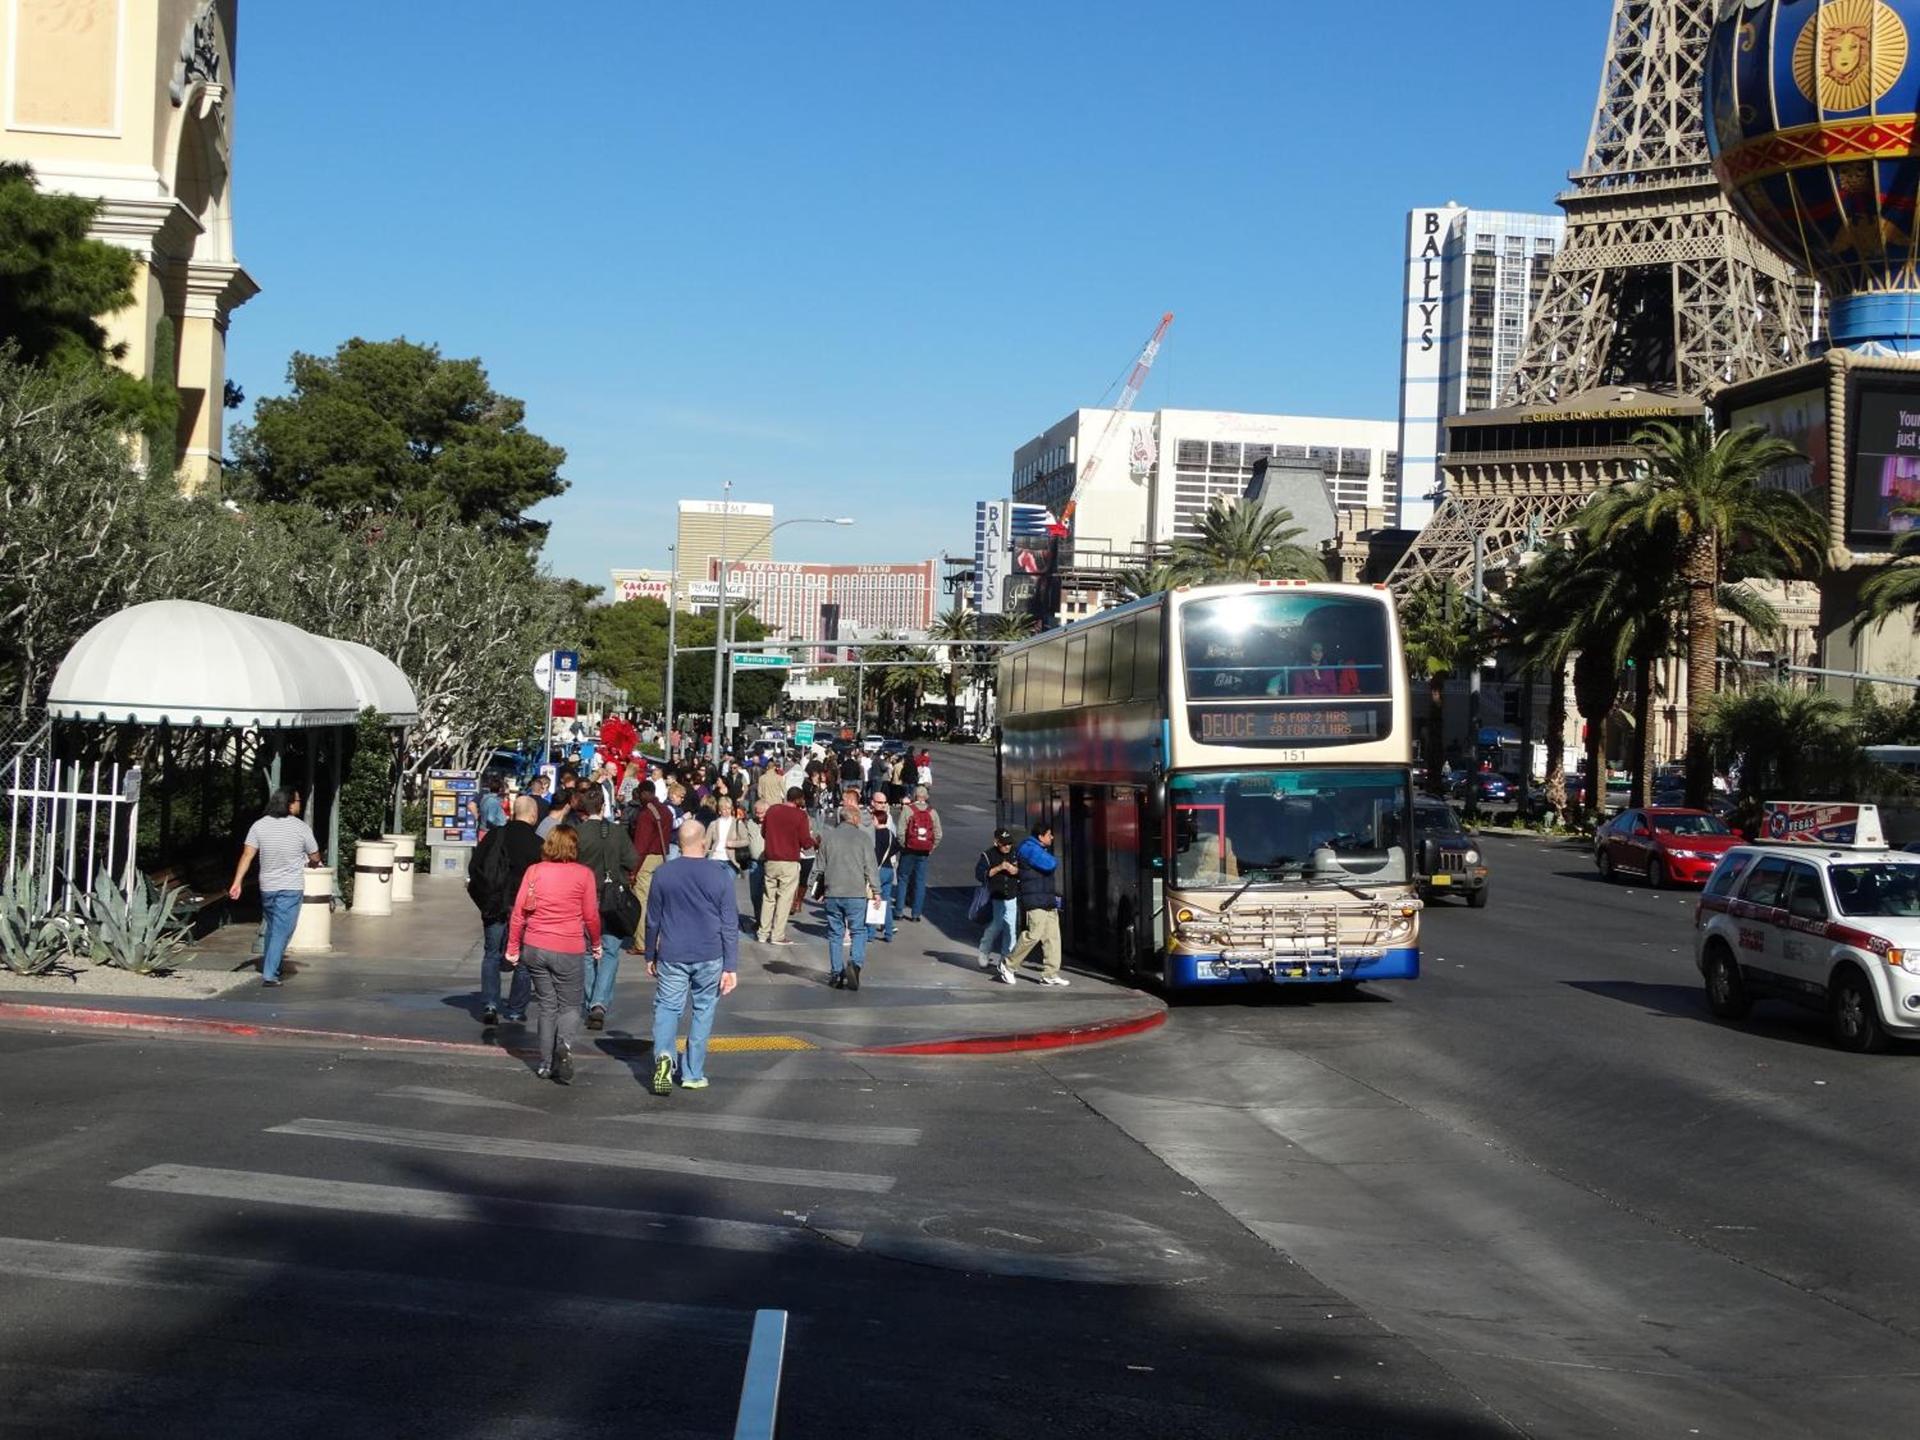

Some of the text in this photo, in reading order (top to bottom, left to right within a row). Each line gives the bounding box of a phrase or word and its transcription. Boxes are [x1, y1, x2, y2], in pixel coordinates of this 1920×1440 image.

[1418, 212, 1441, 351] BALLYS
[1533, 406, 1673, 423] EIFFEL TOWER RESTAURANT
[1896, 430, 1916, 448] just
[706, 502, 748, 514] TRUMP
[984, 506, 1000, 600] BALLYS
[744, 563, 892, 574] TREASURE ISLAND
[623, 582, 667, 591] CAESARS
[704, 584, 744, 594] MIAGE
[743, 656, 776, 665] Bellagio
[1201, 712, 1256, 737] DEUCE
[1289, 712, 1312, 723] FOR
[1313, 712, 1322, 723] 2
[1325, 711, 1349, 723] HRS
[1286, 724, 1311, 736] FOR
[1311, 724, 1326, 736] 24
[1329, 723, 1352, 736] HRS
[1282, 750, 1307, 761] 151
[1788, 819, 1815, 831] VEGAS
